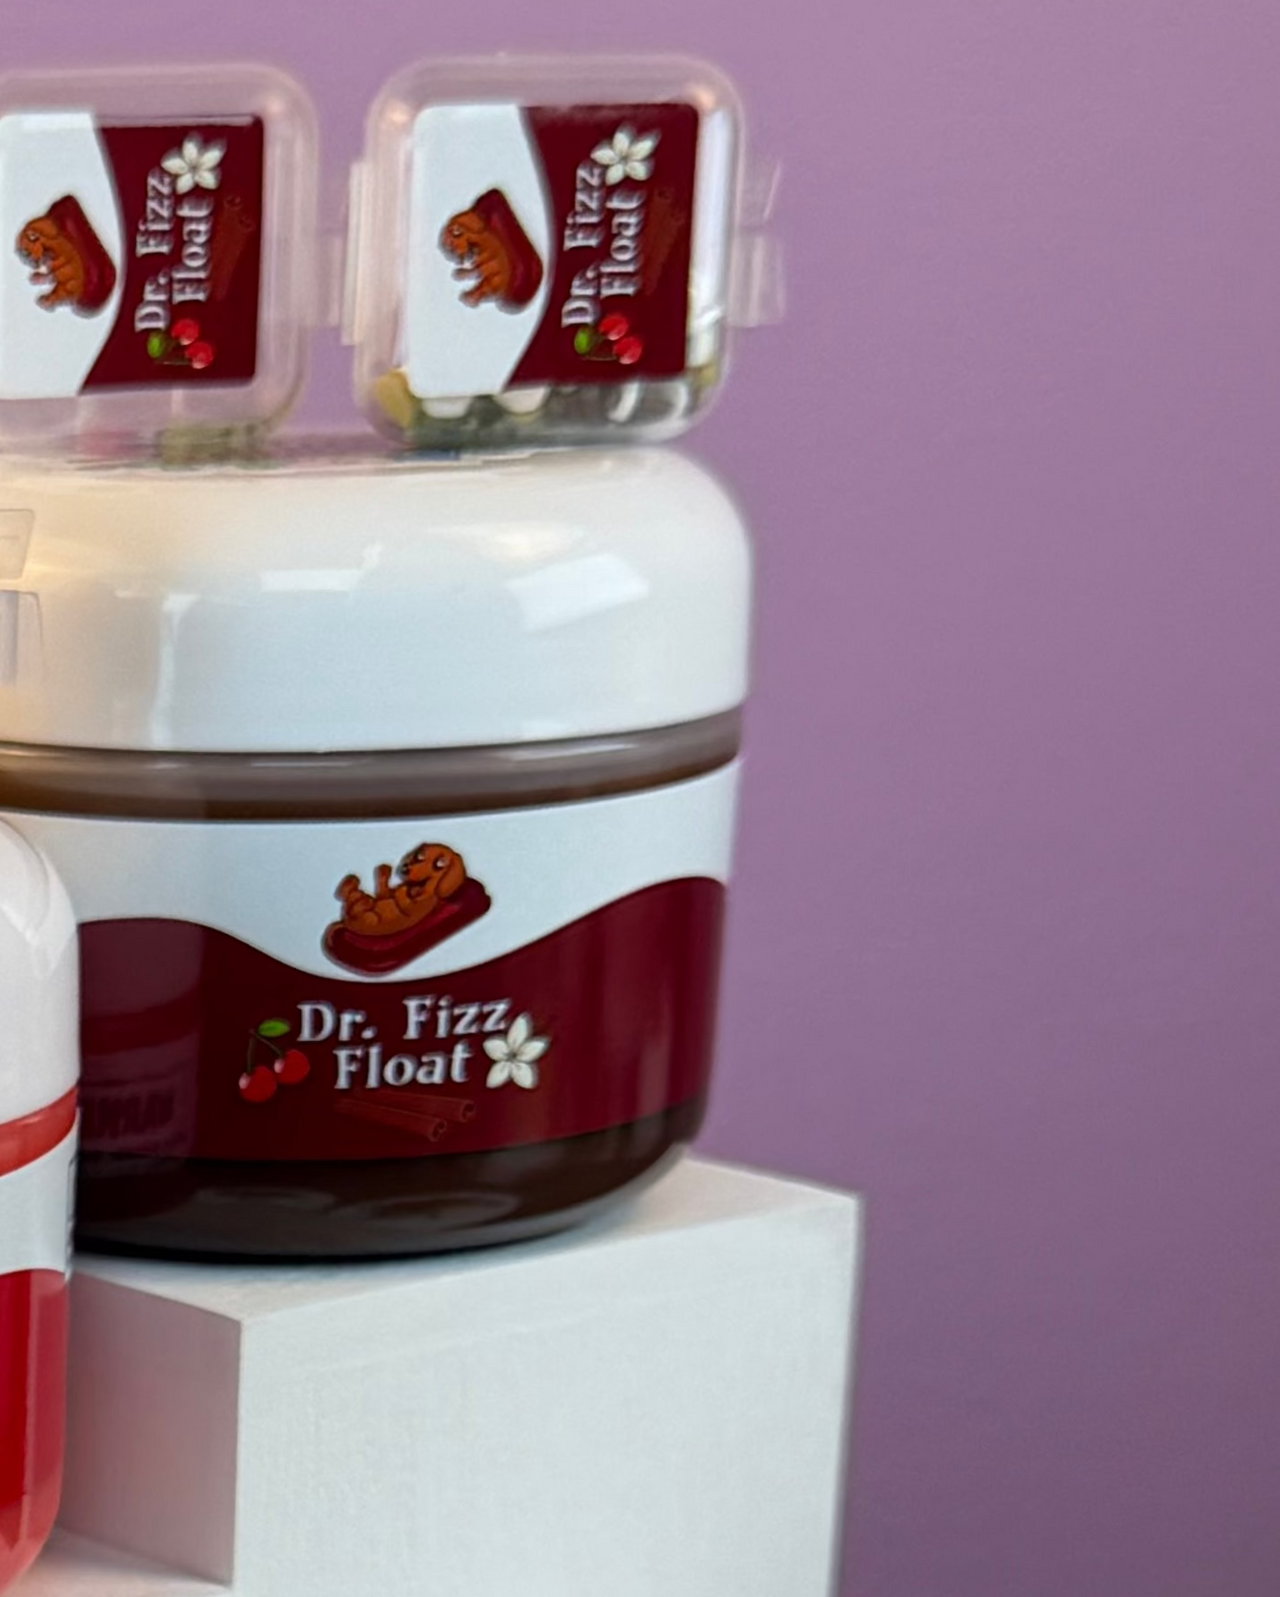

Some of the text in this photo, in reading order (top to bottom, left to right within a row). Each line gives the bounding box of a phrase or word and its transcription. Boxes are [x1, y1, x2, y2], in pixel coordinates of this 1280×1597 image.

[134, 168, 173, 331] Dr. Fizz
[170, 192, 214, 303] Float
[560, 163, 603, 328] Dr. Fizz
[598, 182, 644, 298] Float
[296, 994, 513, 1043] Dr. Fizz
[332, 1041, 475, 1090] Float
